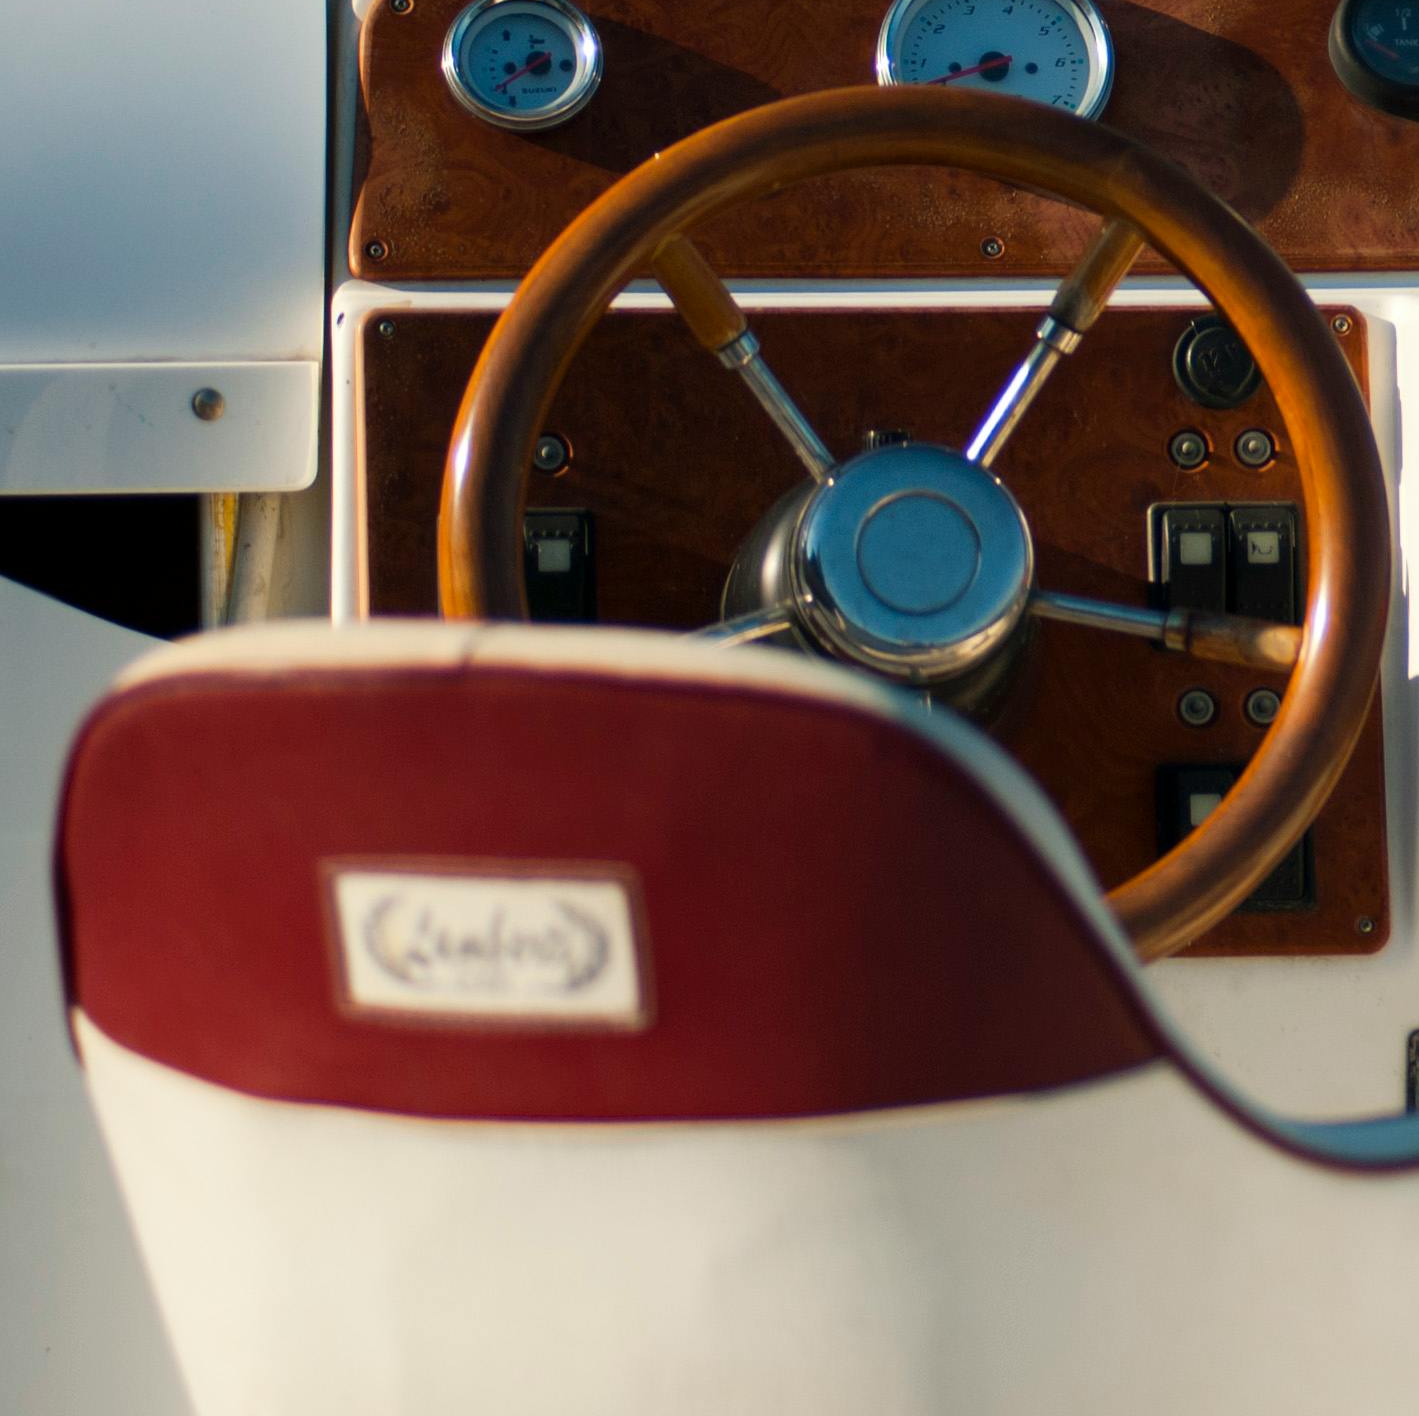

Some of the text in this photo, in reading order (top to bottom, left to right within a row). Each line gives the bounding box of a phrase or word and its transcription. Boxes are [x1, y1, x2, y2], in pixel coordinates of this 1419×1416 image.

[963, 5, 975, 15] 3
[1002, 5, 1013, 15] 4
[933, 24, 945, 33] 2
[1038, 26, 1049, 35] 5
[921, 58, 927, 68] 1
[1055, 58, 1066, 67] 6
[1052, 95, 1063, 105] 7
